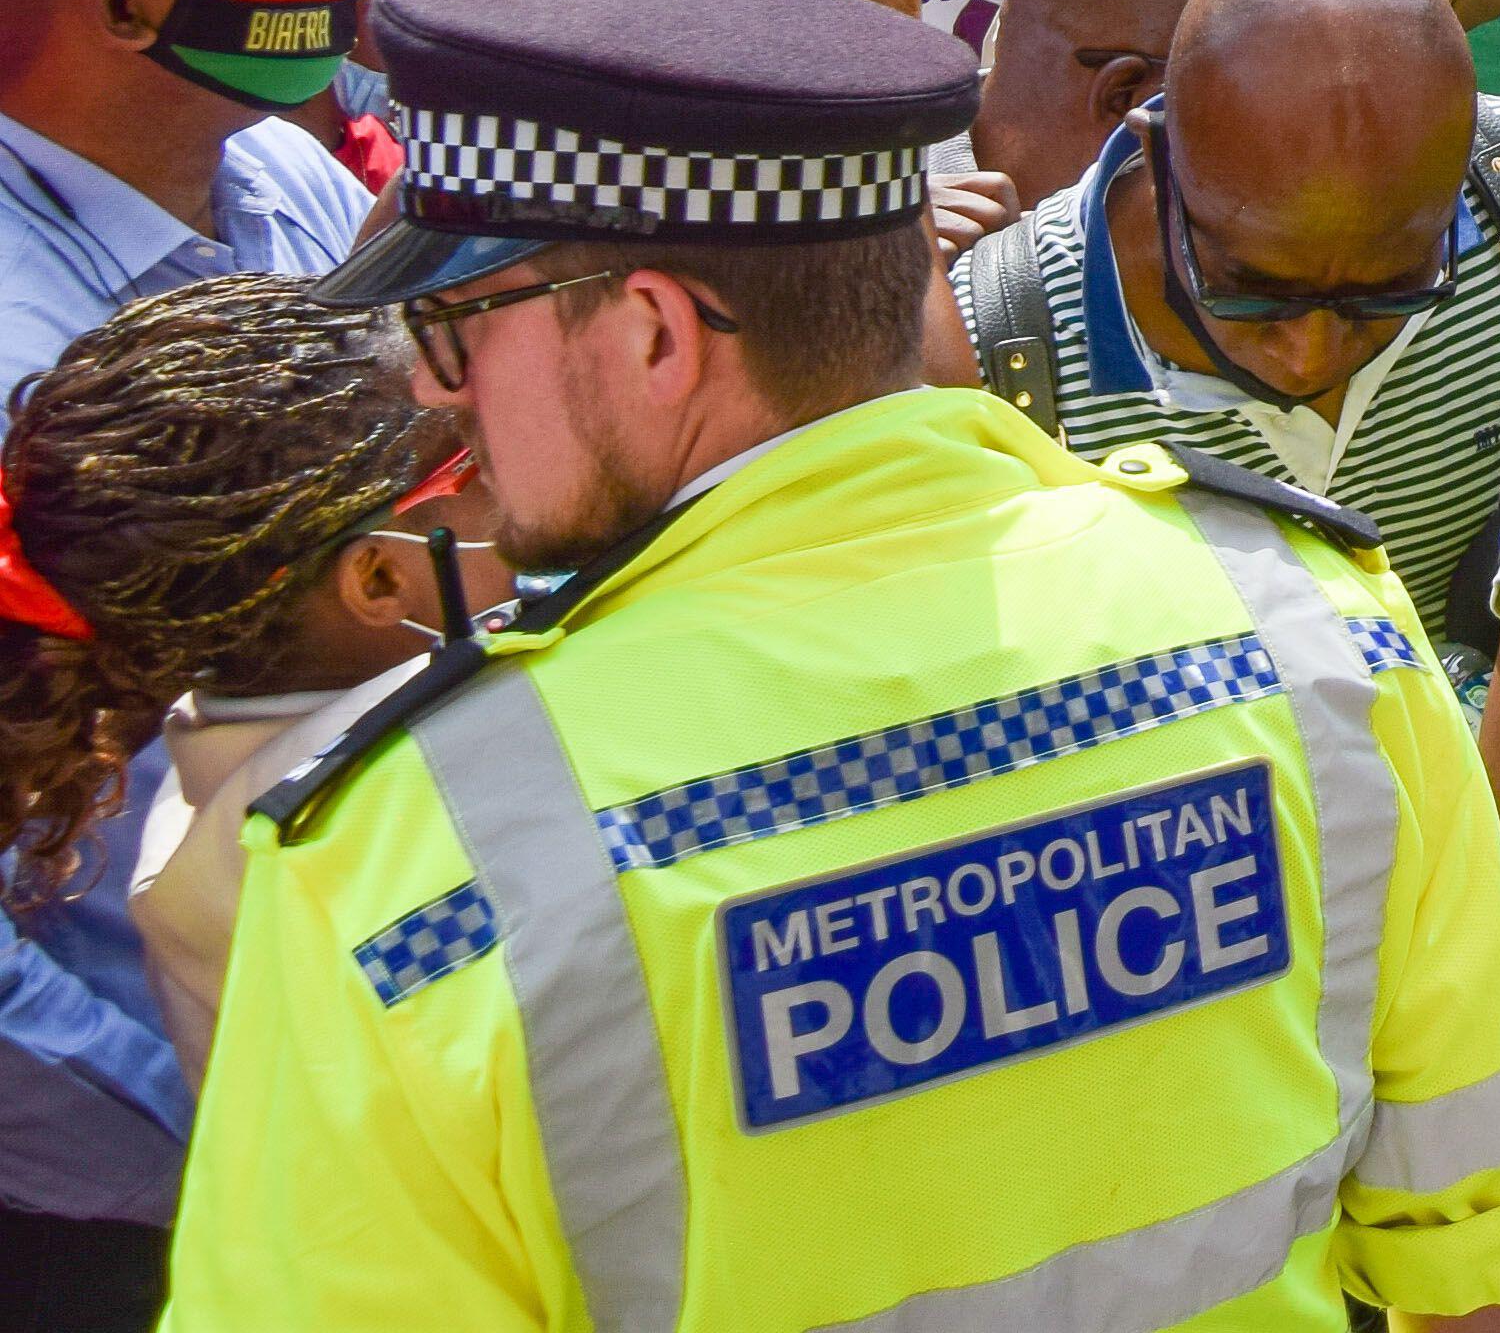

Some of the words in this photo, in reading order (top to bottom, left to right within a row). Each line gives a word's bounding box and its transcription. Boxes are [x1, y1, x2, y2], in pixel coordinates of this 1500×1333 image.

[245, 5, 332, 54] BIAFRA
[750, 787, 1255, 974] METROPOLITAN
[760, 855, 1271, 1102] POLICE
